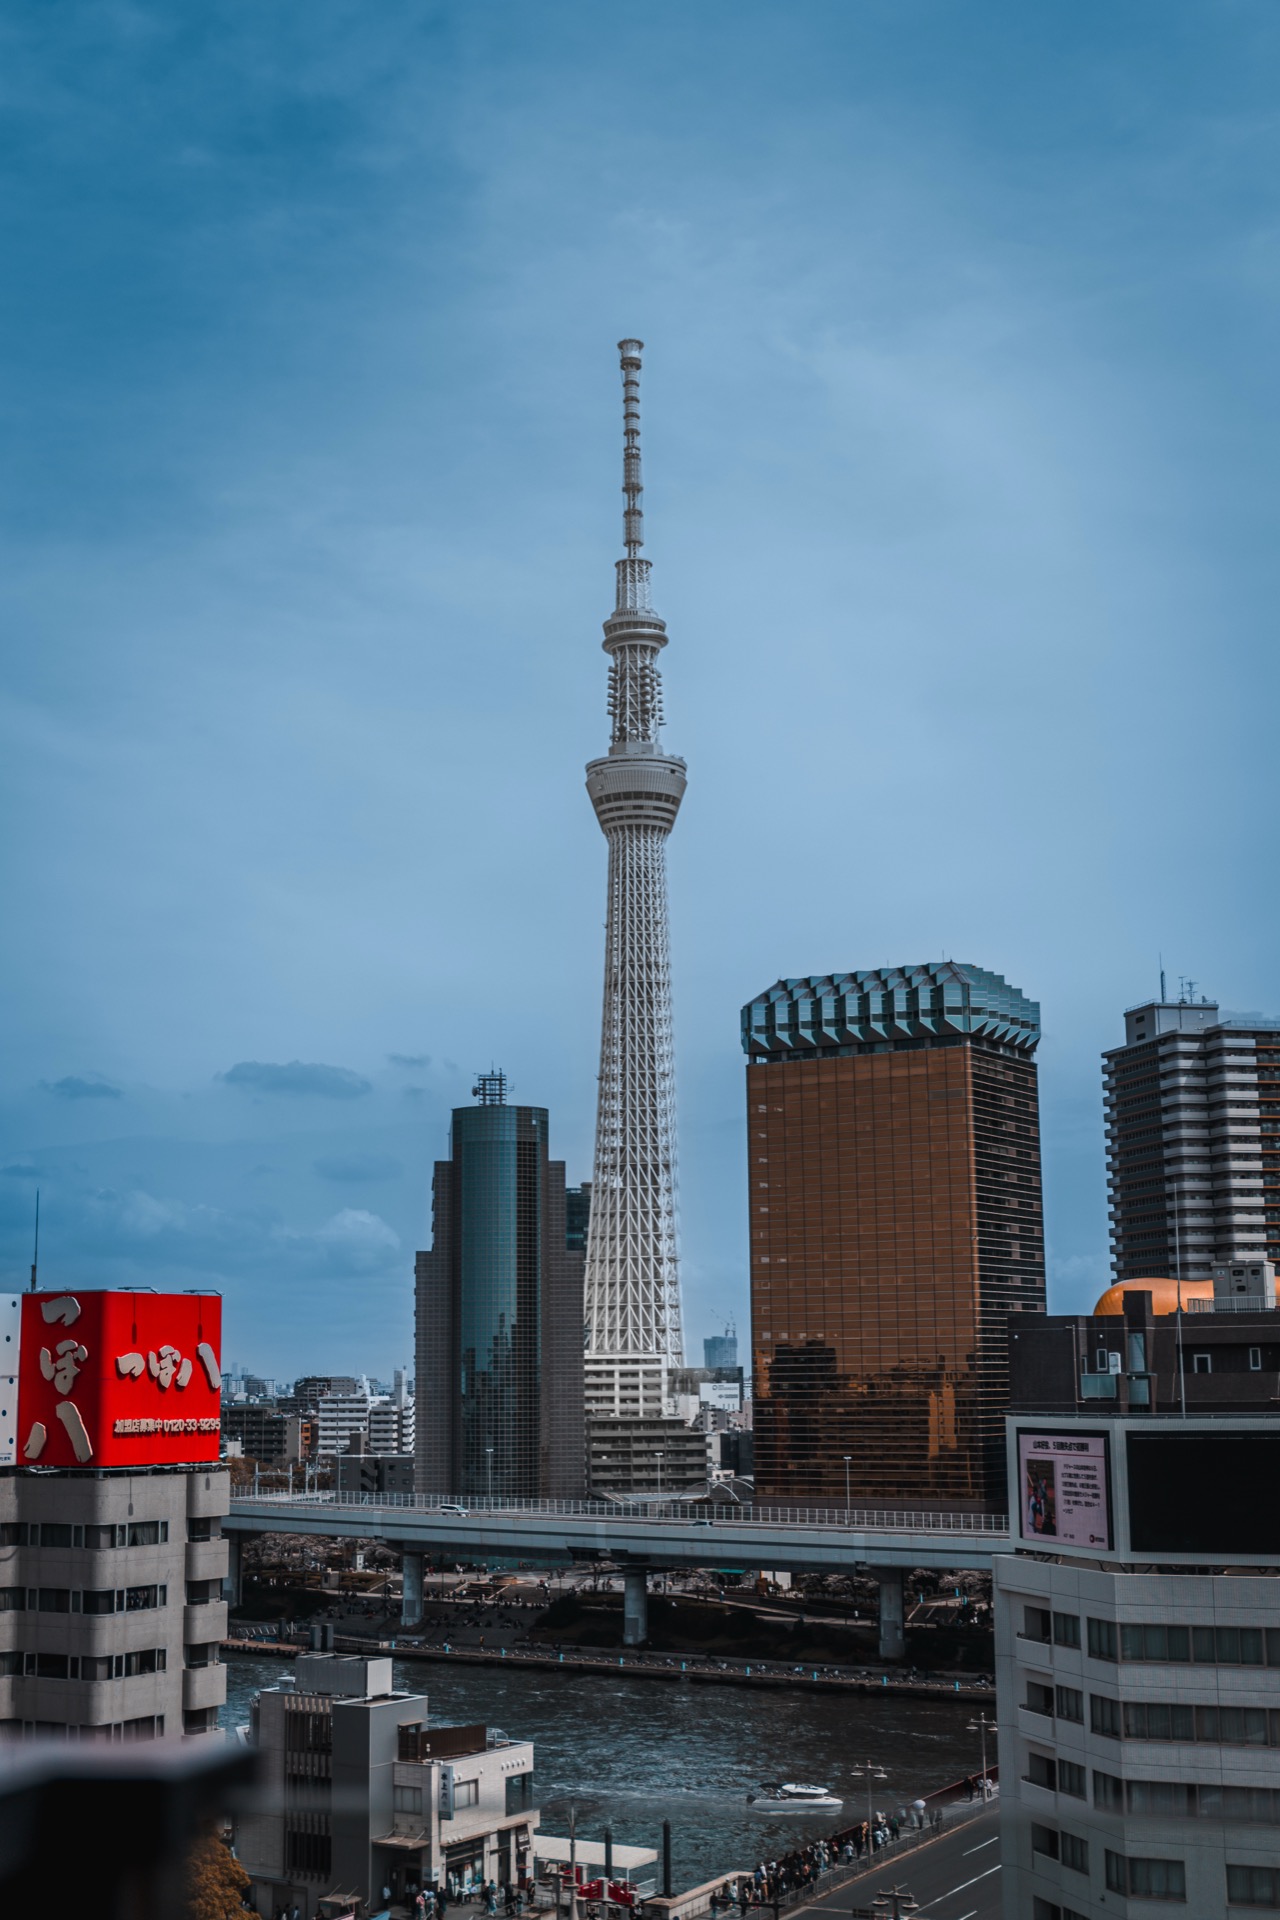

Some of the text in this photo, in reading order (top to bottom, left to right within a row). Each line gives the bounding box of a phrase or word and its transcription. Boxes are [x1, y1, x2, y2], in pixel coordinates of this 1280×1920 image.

[23, 1296, 93, 1463] つぼ八
[114, 1342, 221, 1389] つぼ八
